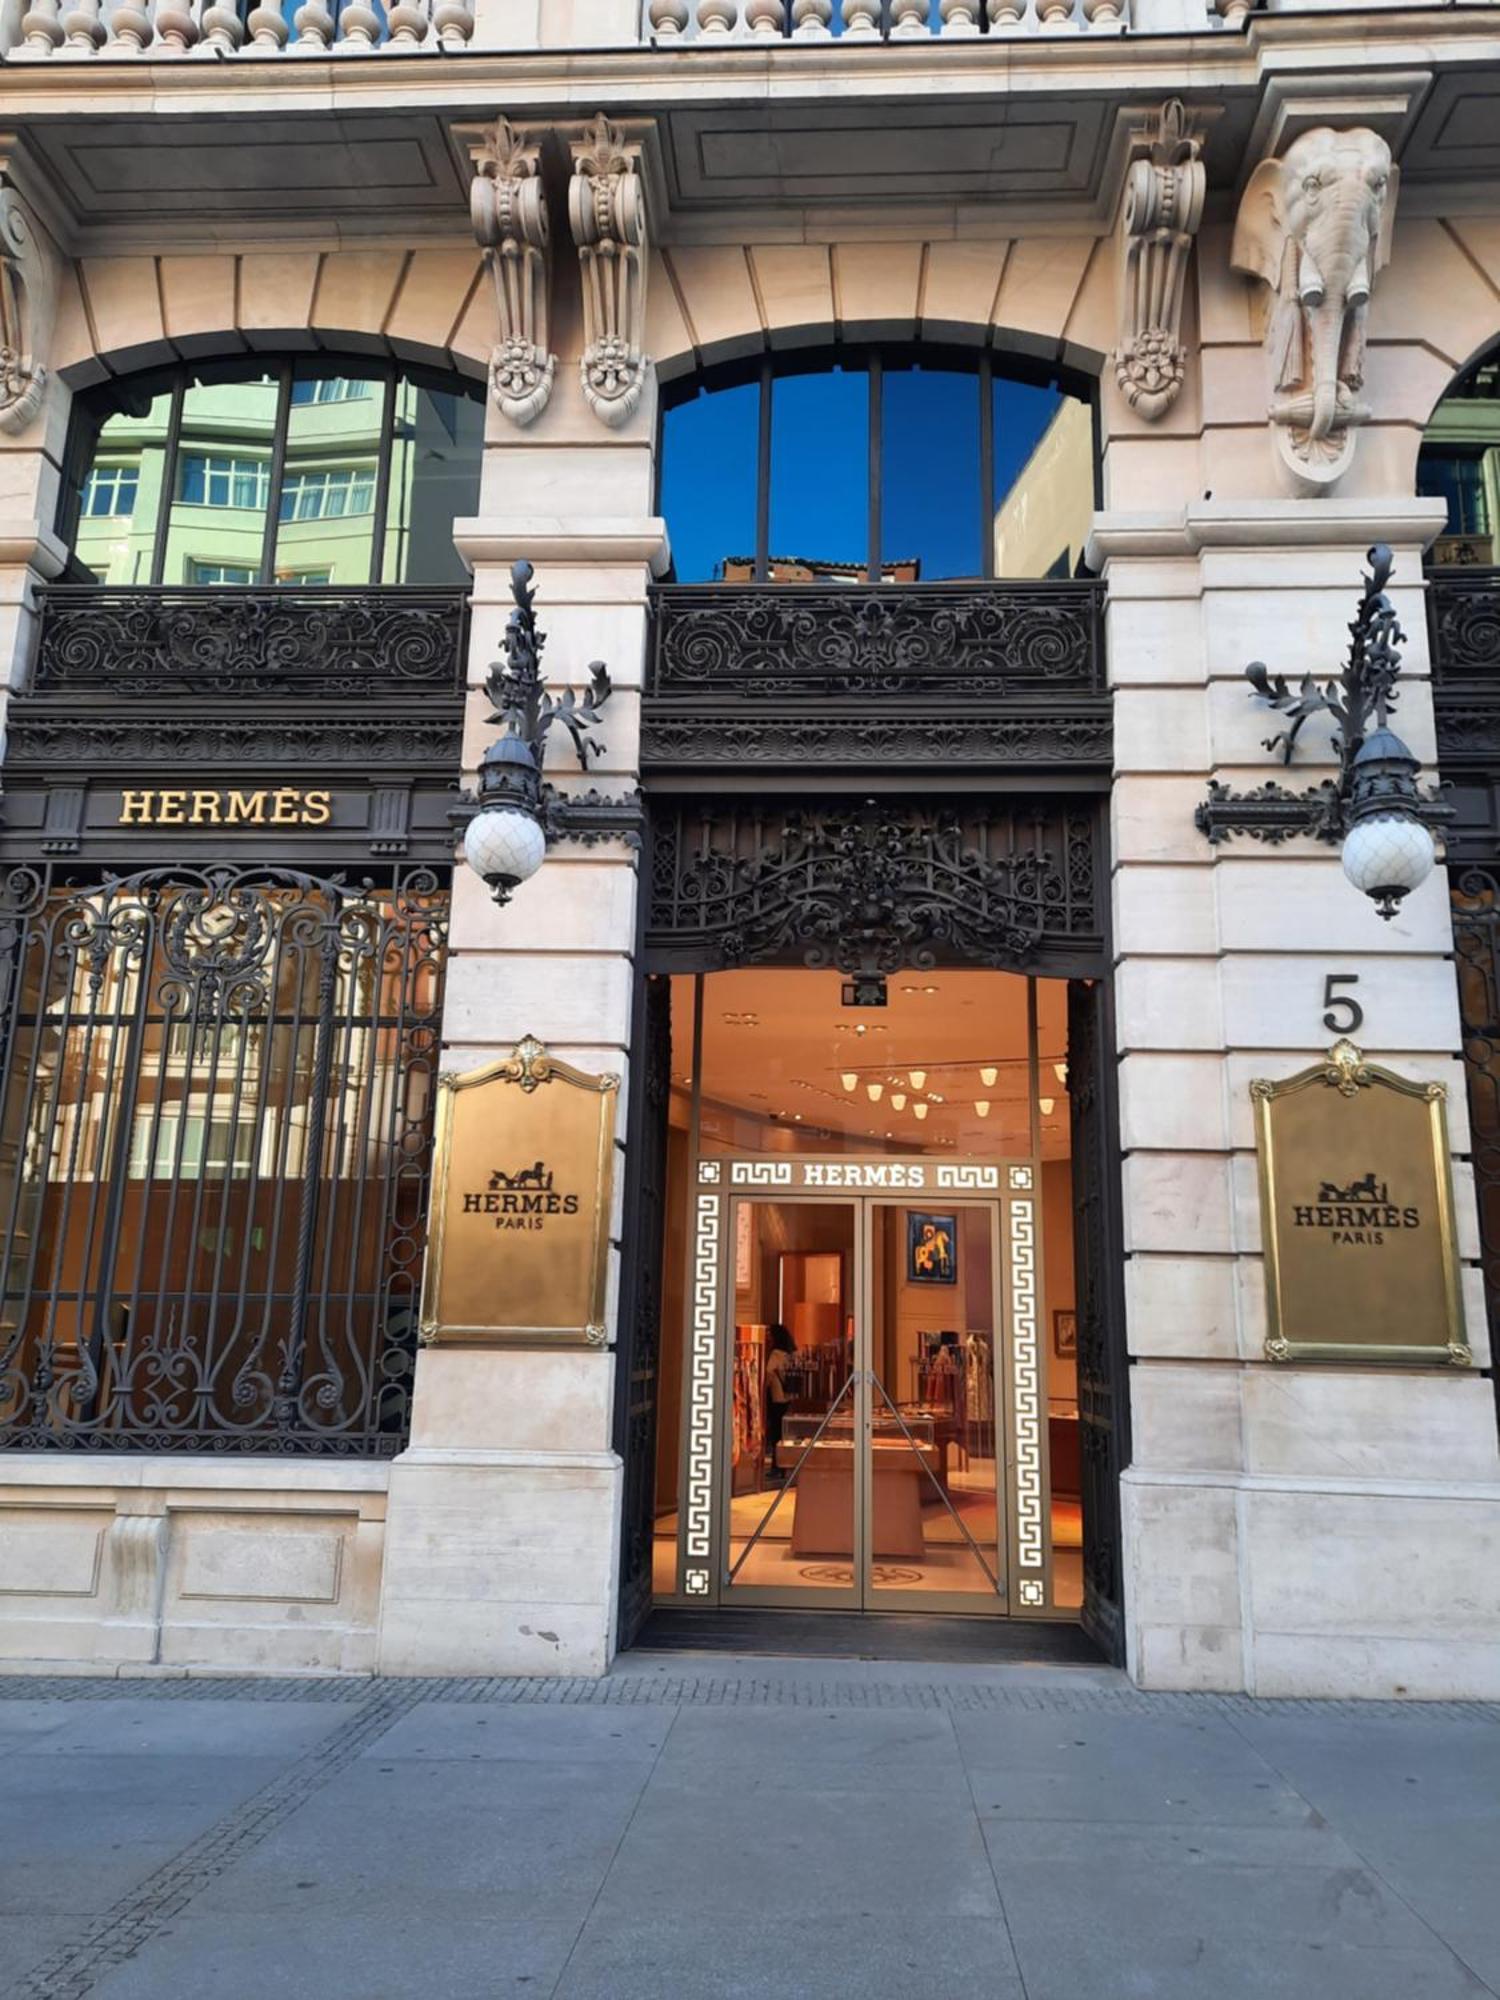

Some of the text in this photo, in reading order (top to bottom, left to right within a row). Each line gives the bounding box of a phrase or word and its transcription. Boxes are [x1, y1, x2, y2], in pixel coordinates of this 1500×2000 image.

[119, 787, 331, 824] HERMÈS
[1323, 974, 1364, 1034] 5
[495, 1217, 544, 1230] PARIS
[1332, 1231, 1384, 1245] PARIS
